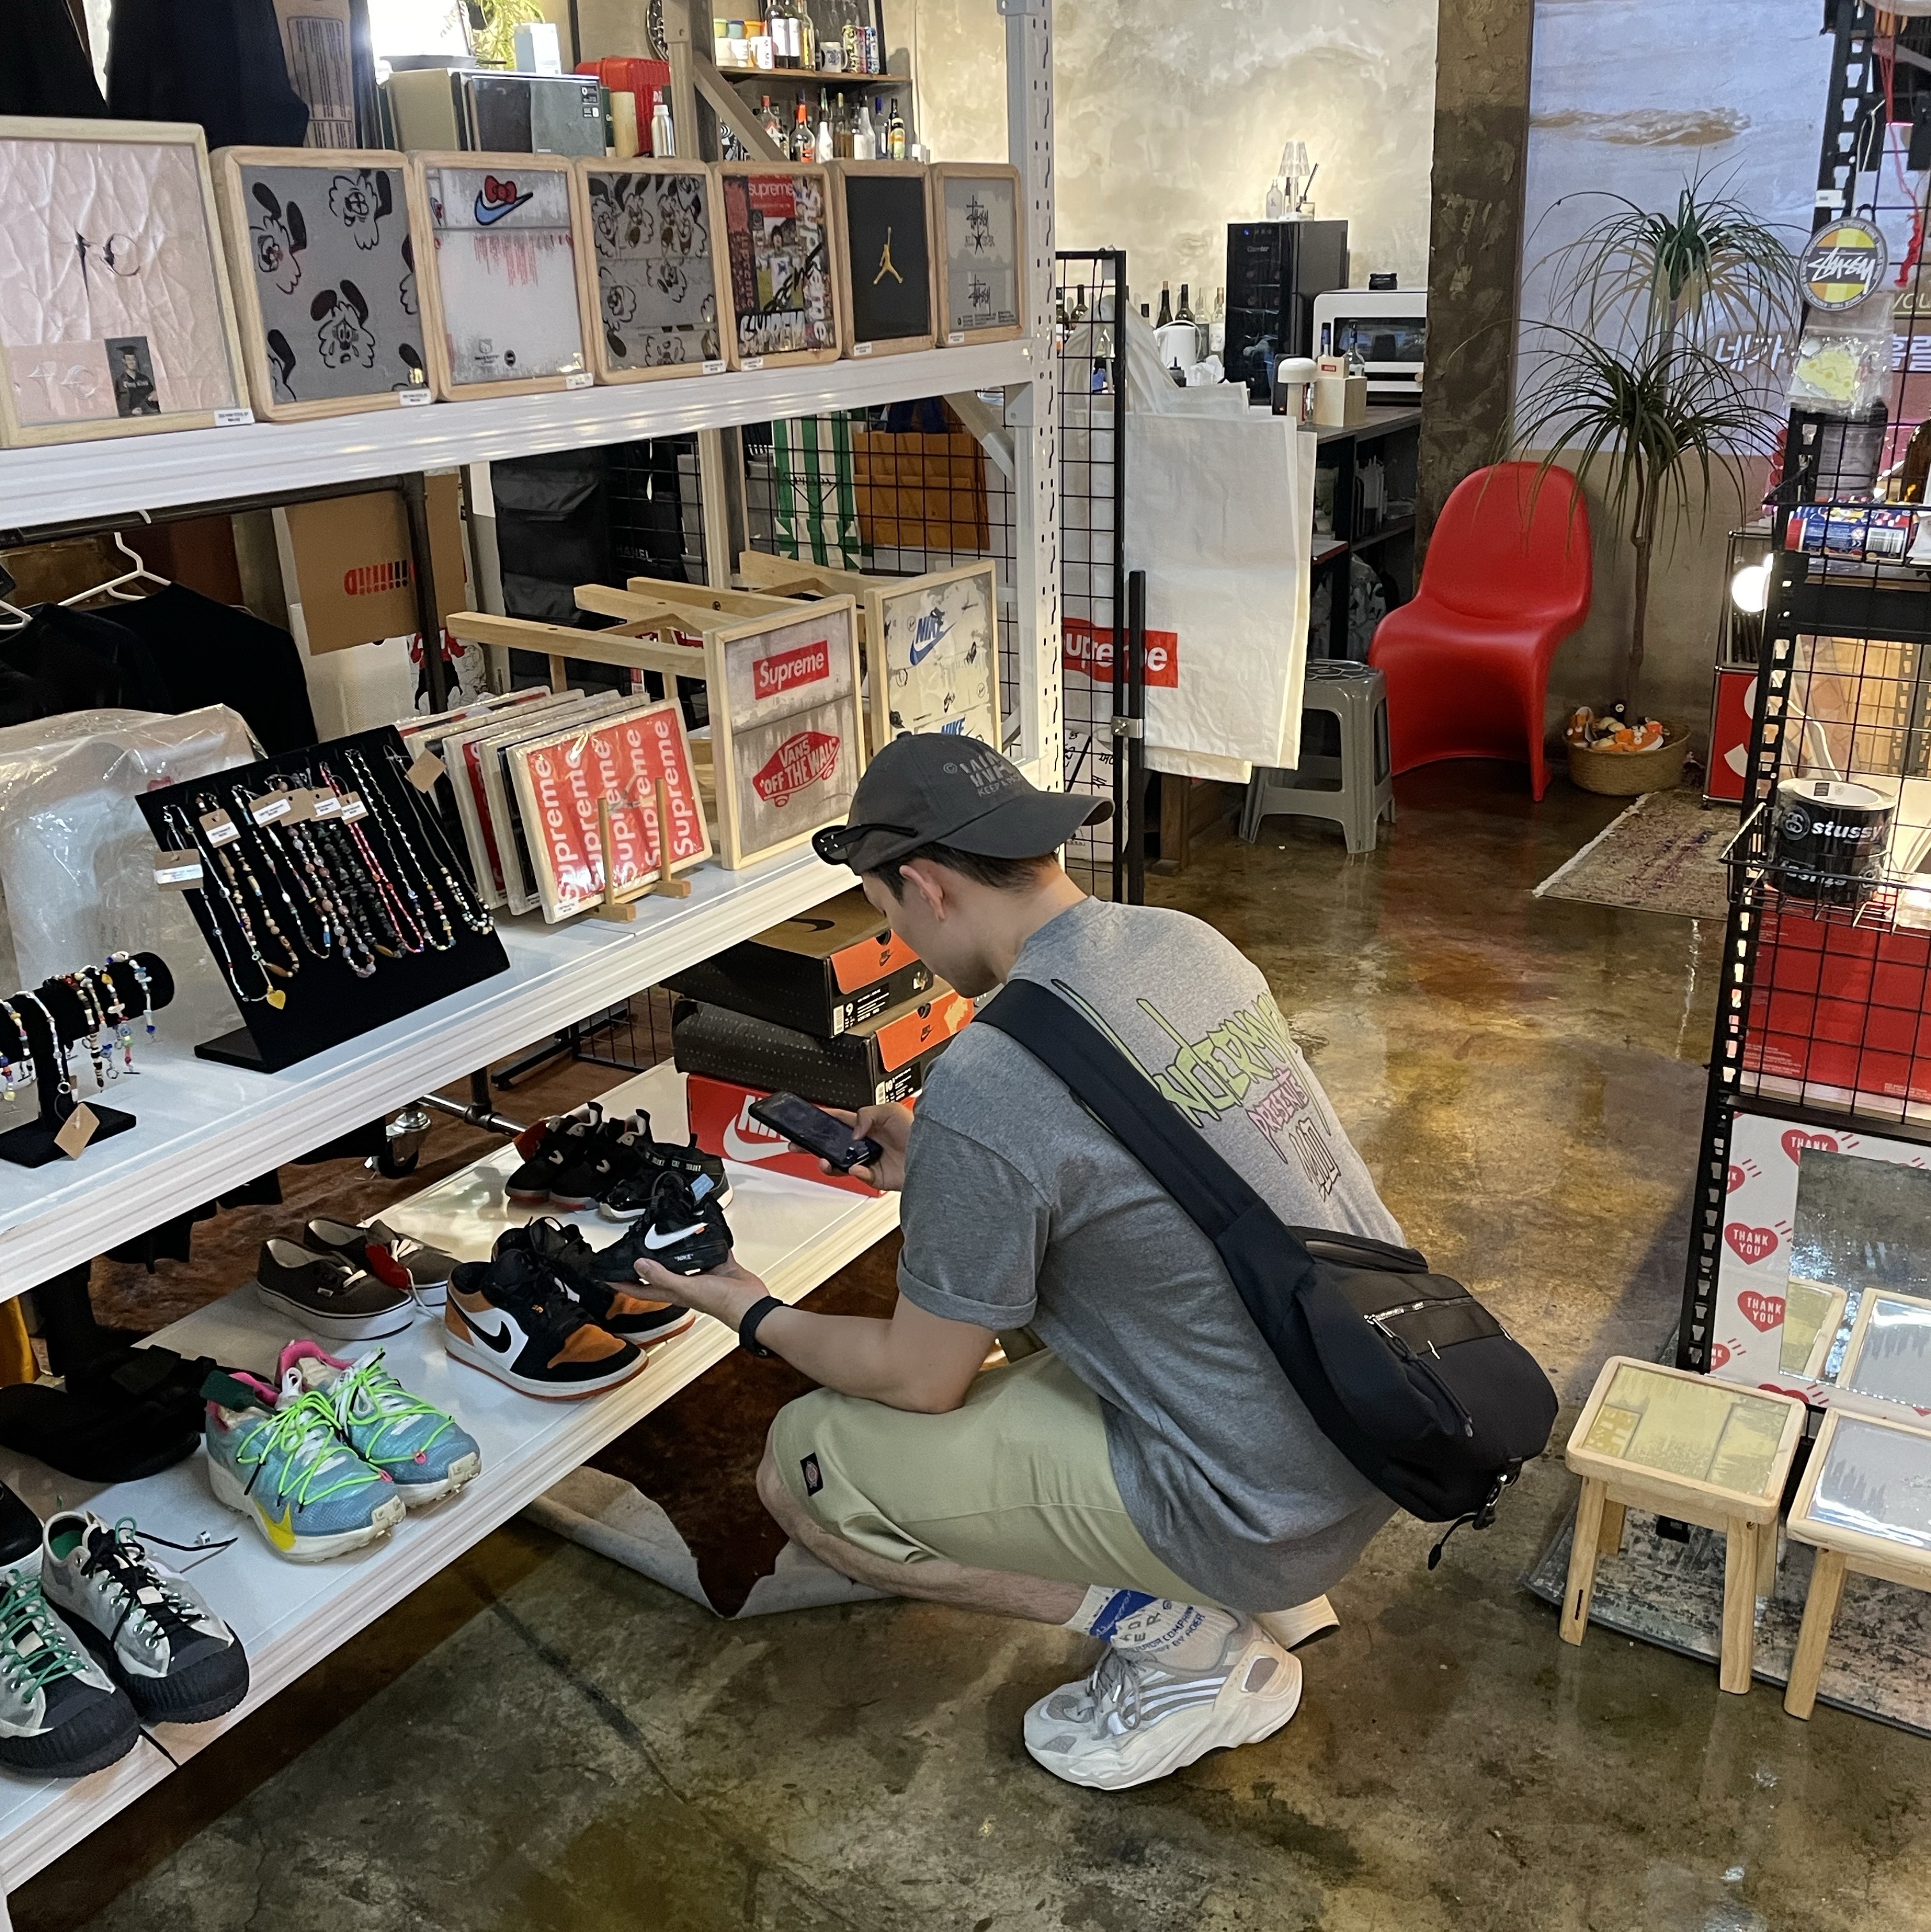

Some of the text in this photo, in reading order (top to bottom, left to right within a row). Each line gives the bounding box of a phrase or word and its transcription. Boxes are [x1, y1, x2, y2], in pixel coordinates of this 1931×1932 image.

[1063, 632, 1169, 672] upree
[759, 651, 825, 690] Supreme
[778, 734, 811, 768] VANS
[784, 756, 810, 789] THE
[654, 720, 694, 856] Supreme
[1811, 821, 1883, 841] stussy
[845, 1002, 854, 1017] 9
[1791, 1136, 1828, 1152] THANK
[1733, 1229, 1769, 1246] THANK
[1739, 1242, 1761, 1256] YOU
[1746, 1297, 1782, 1315] THANK
[1752, 1310, 1774, 1325] YOU
